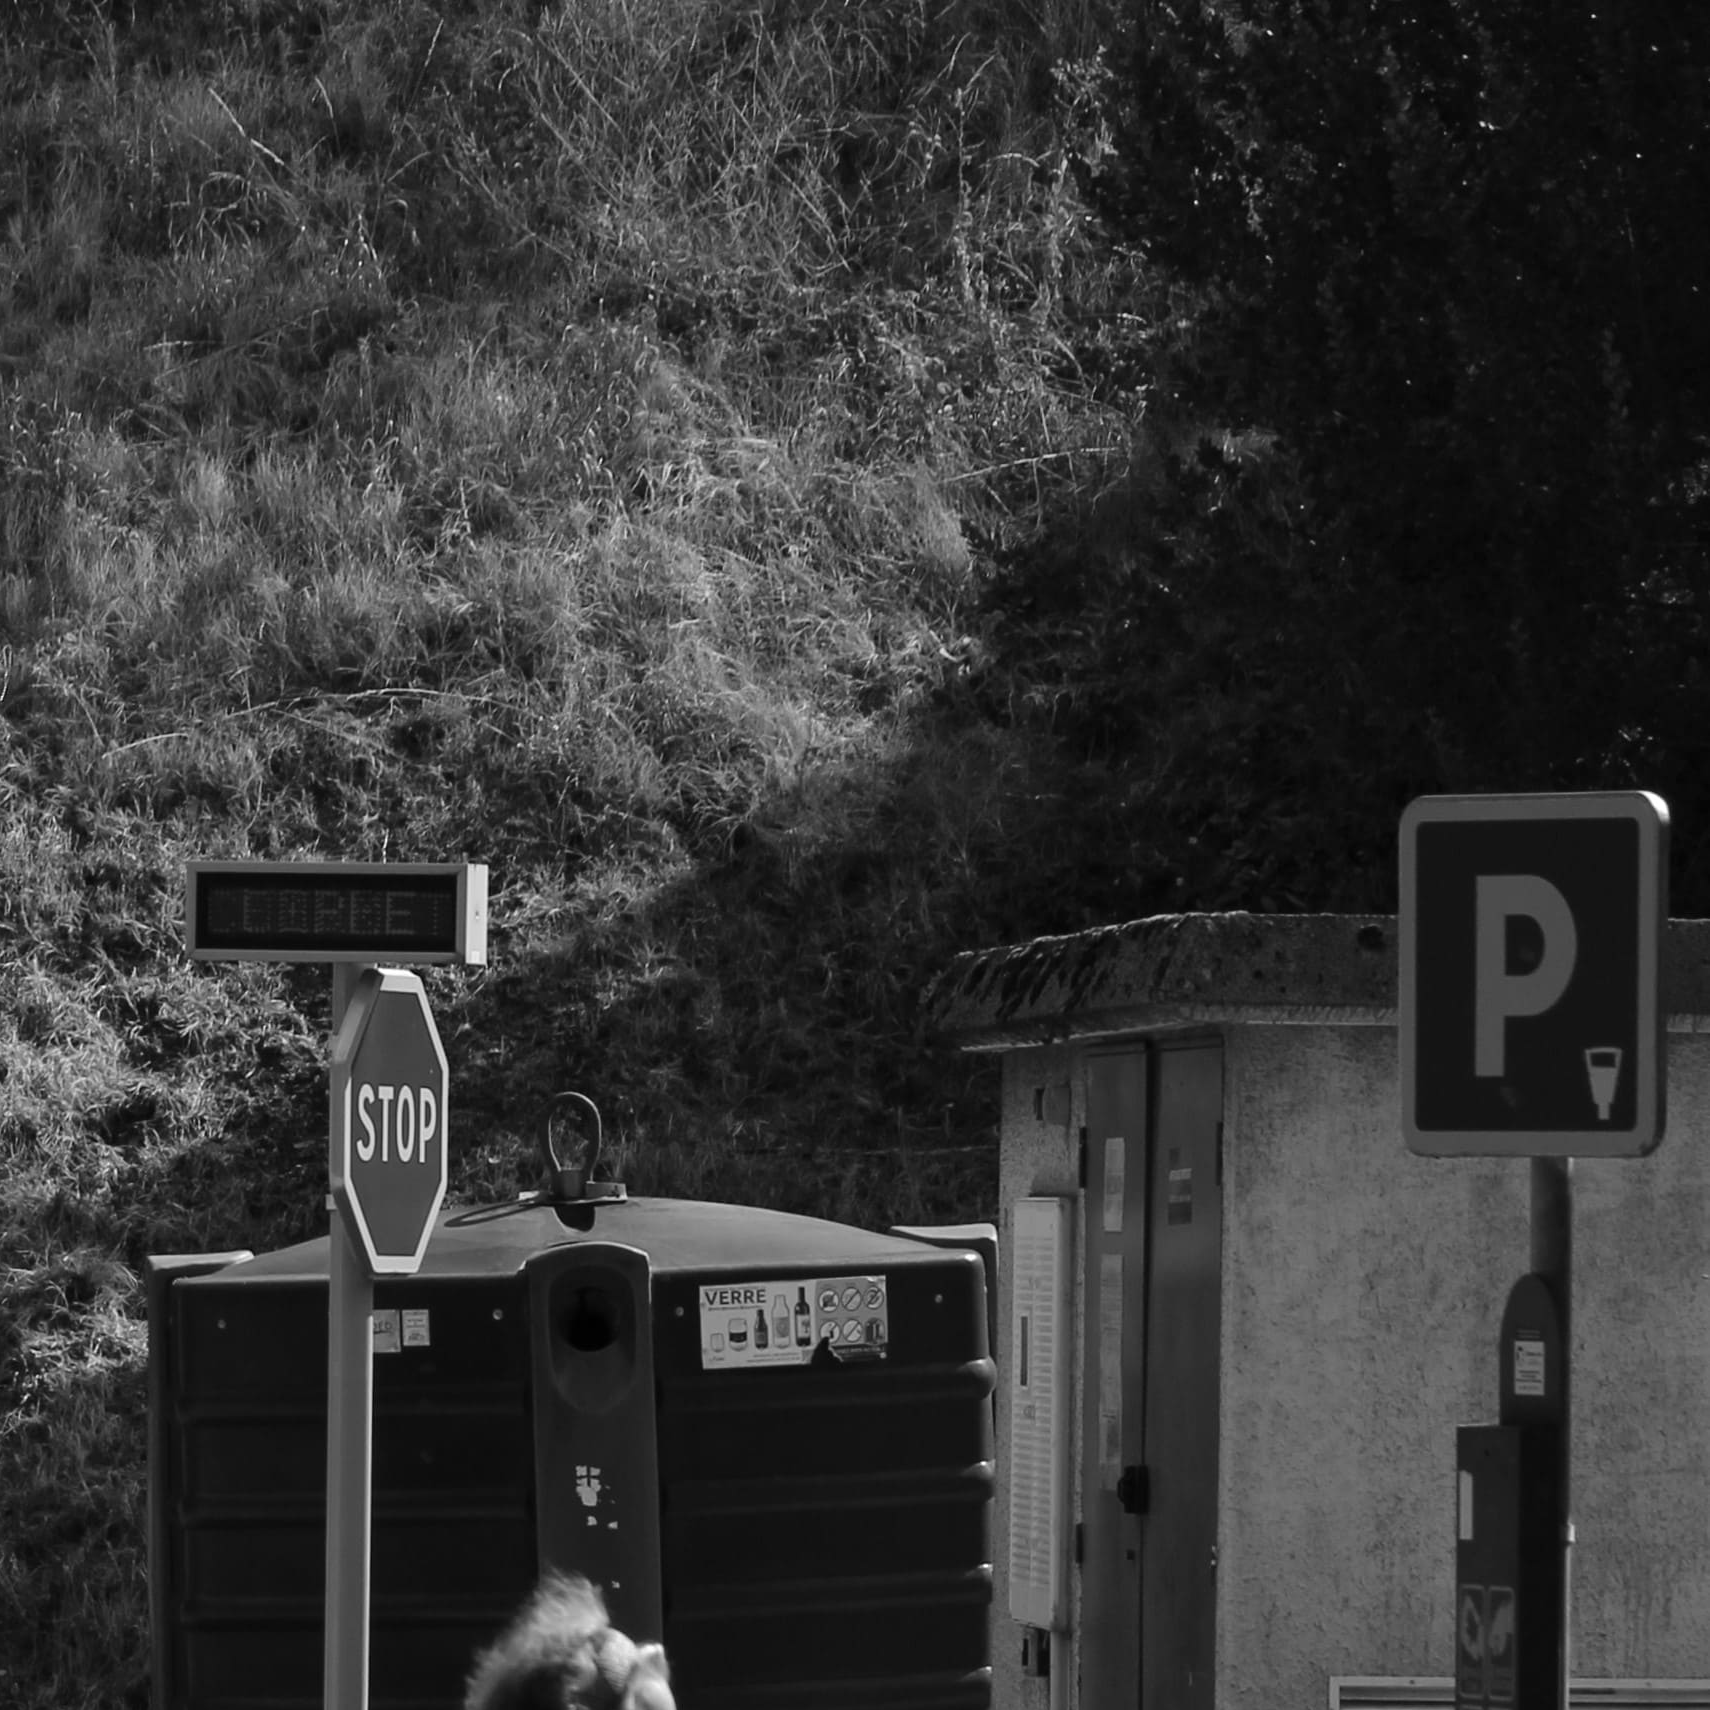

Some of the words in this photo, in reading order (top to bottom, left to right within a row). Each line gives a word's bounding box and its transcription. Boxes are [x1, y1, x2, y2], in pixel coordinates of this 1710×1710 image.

[1474, 874, 1578, 1077] P
[356, 1083, 437, 1164] STOP
[705, 1289, 767, 1305] VERRE
